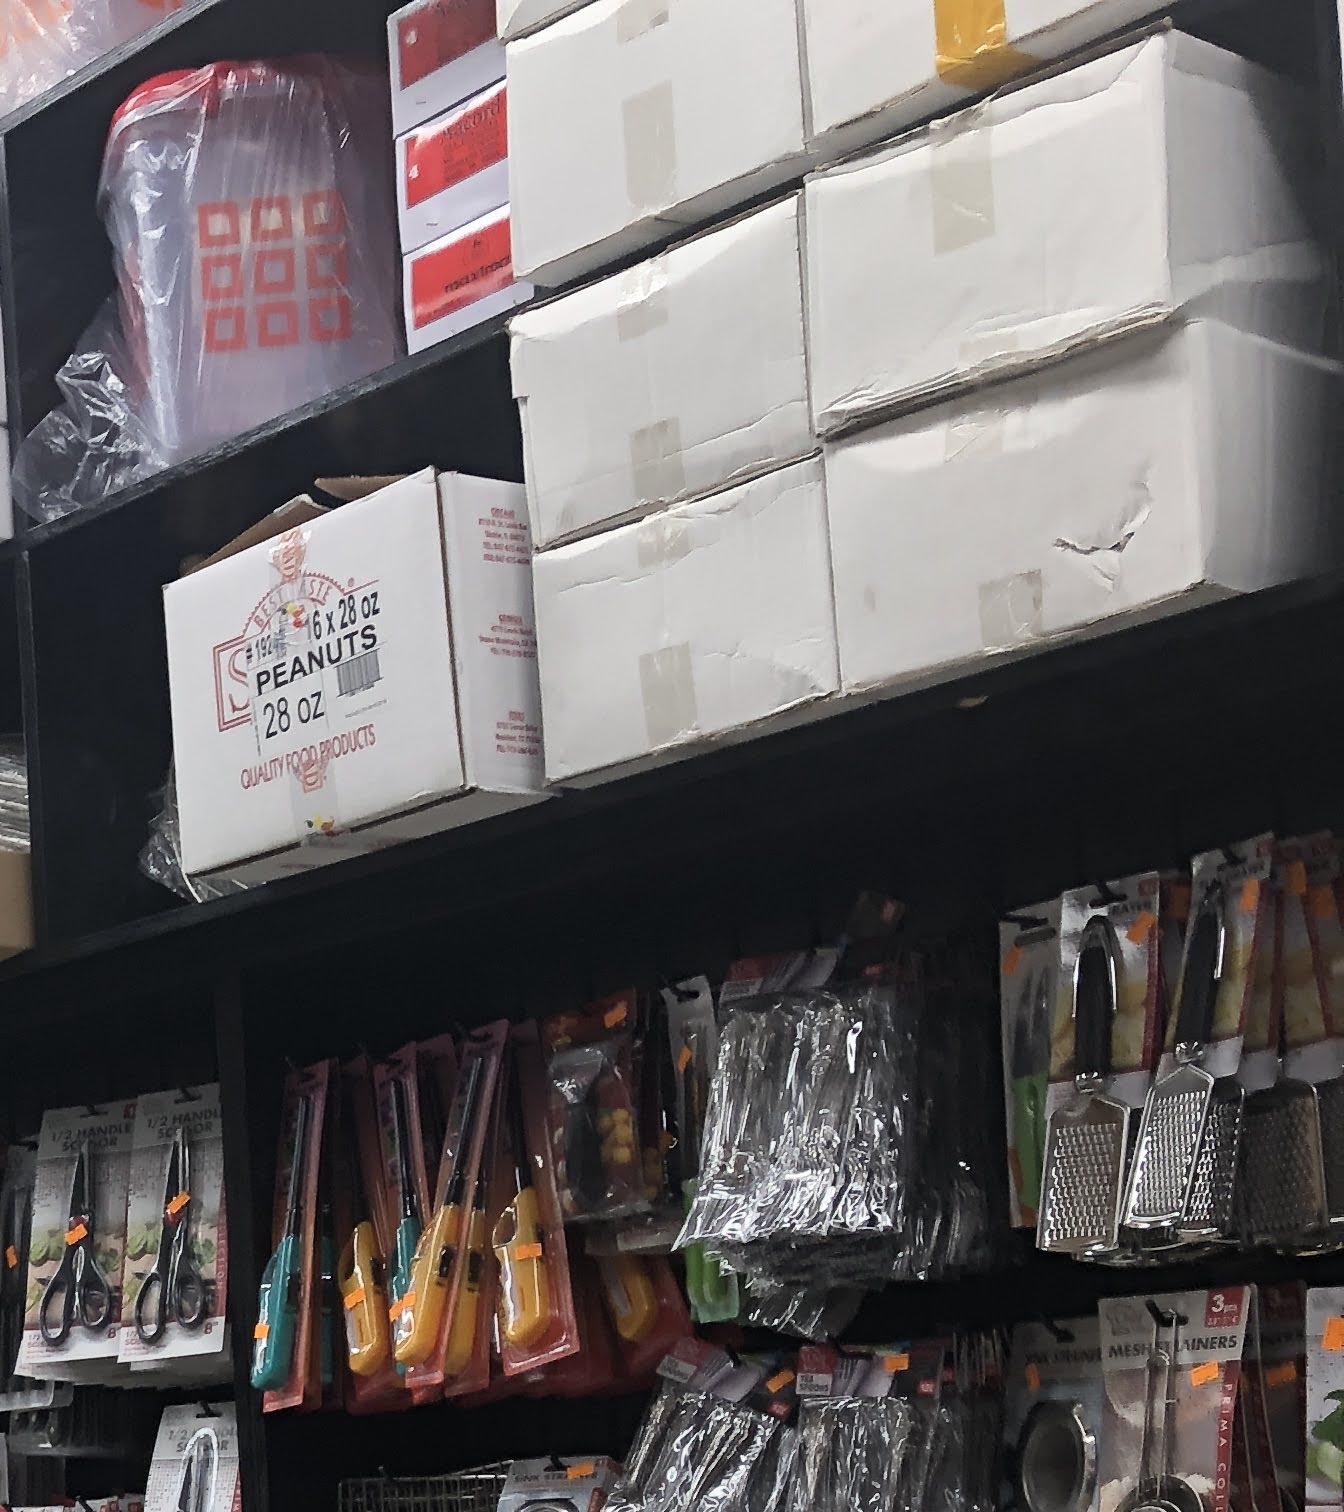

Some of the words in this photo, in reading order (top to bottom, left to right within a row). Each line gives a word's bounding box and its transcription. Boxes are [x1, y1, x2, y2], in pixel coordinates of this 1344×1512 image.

[253, 587, 284, 629] BEST
[338, 594, 357, 630] 28
[361, 591, 381, 620] OZ
[256, 623, 378, 696] PEANUTS
[263, 696, 291, 740] 28
[297, 690, 325, 724] OZ
[240, 753, 286, 790] QUALITY
[286, 745, 318, 776] FOOD
[319, 723, 377, 762] PRODUCTS
[77, 1121, 132, 1137] HANDLE
[172, 1109, 221, 1125] HANDL
[1156, 1335, 1238, 1354] STAINERS
[1219, 1382, 1234, 1447] PRIMA
